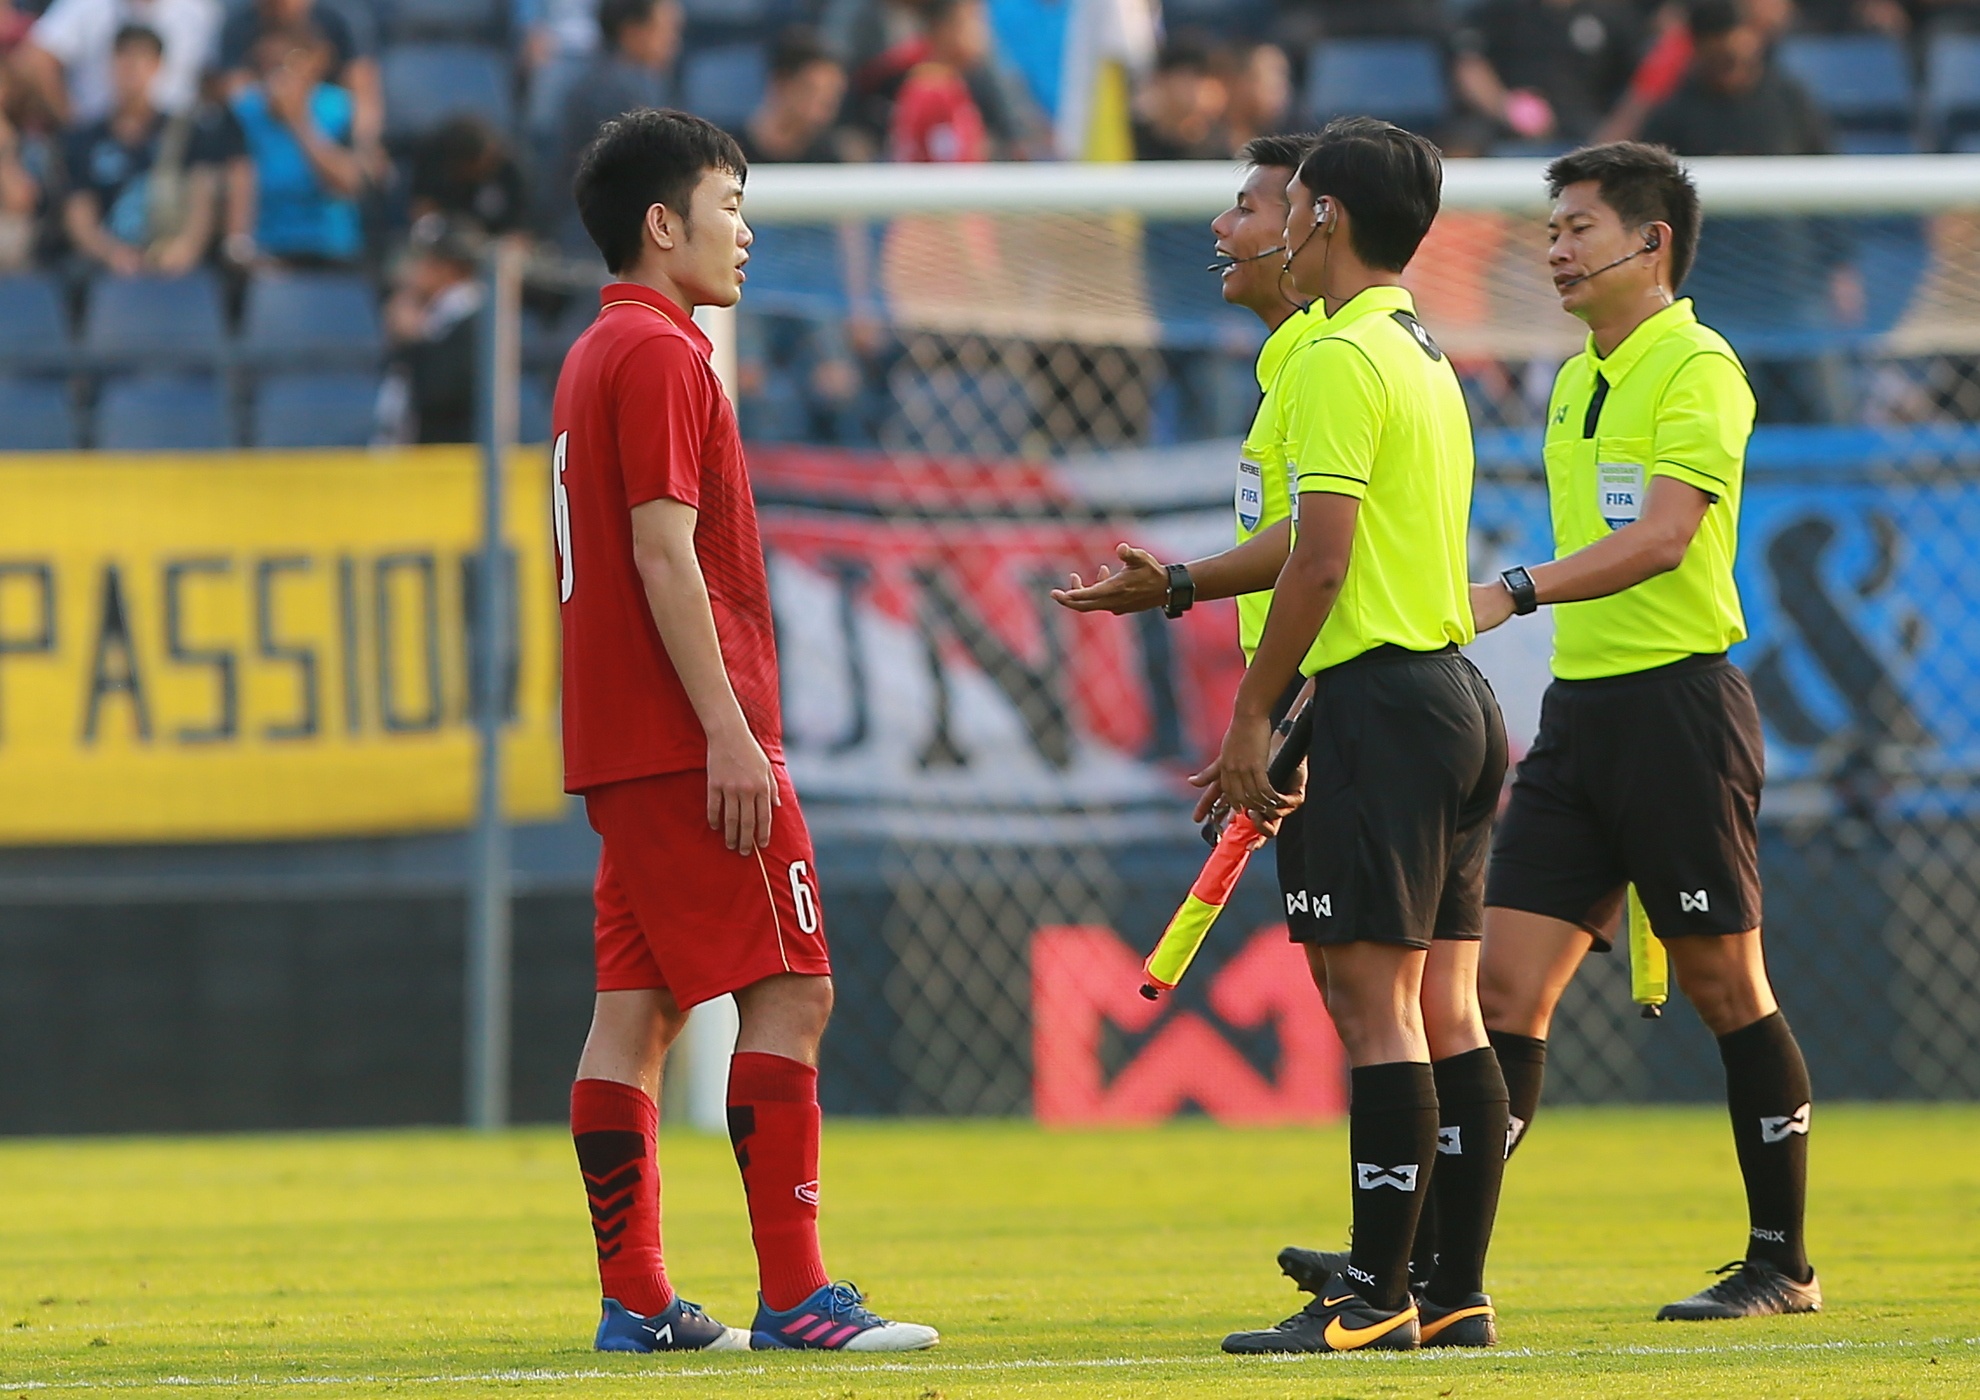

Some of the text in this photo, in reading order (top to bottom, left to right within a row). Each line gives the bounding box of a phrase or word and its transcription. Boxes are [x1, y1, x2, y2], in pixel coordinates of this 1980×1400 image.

[552, 430, 575, 604] 6
[1241, 488, 1258, 504] FIFA
[1606, 493, 1634, 506] FIFA
[0, 549, 521, 748] PASSION
[788, 859, 818, 935] 6
